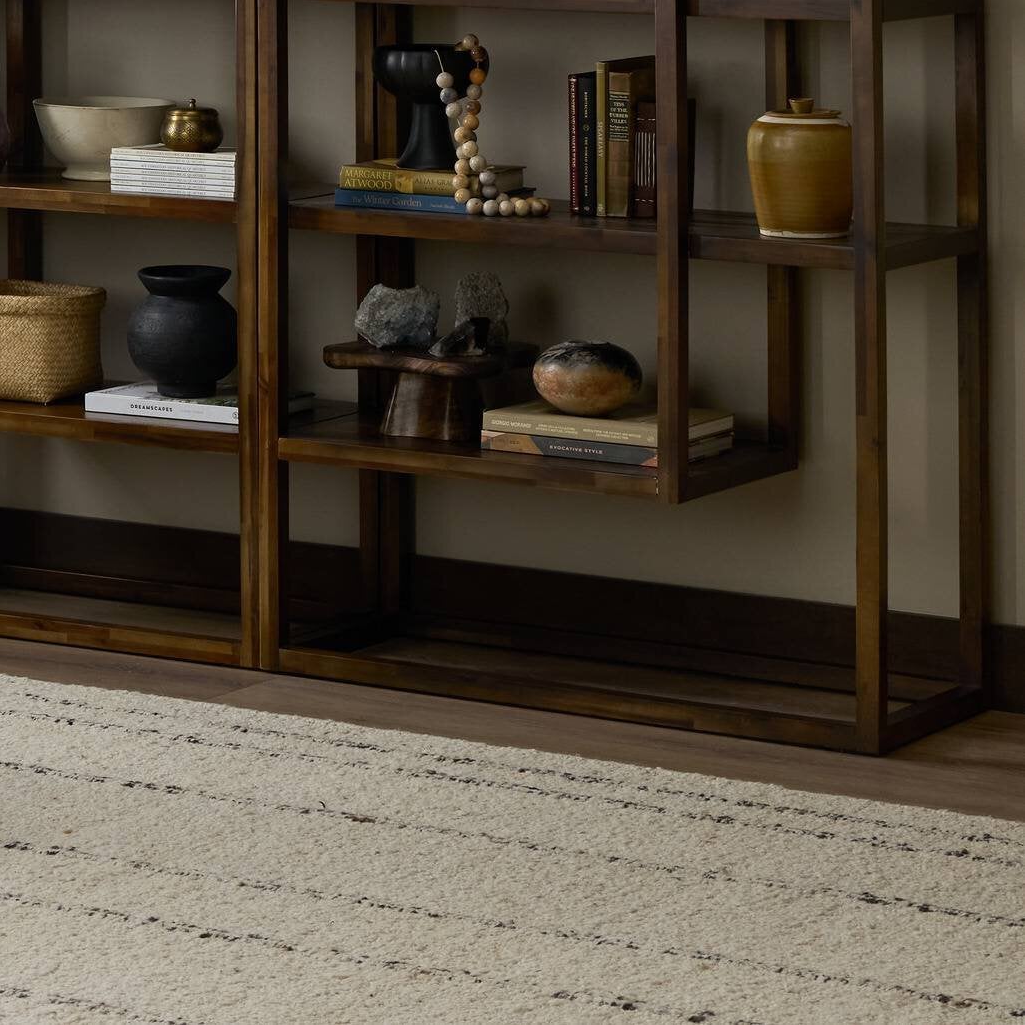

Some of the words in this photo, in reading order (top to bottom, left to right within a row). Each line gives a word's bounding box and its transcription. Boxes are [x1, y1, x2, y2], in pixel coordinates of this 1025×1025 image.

[344, 168, 392, 180] MARGARET
[344, 178, 393, 190] ATWOOD
[391, 196, 422, 207] Garden
[130, 403, 173, 412] DREAMSCAPES
[549, 444, 583, 453] EVOCATIVE
[584, 447, 603, 455] STYLE
